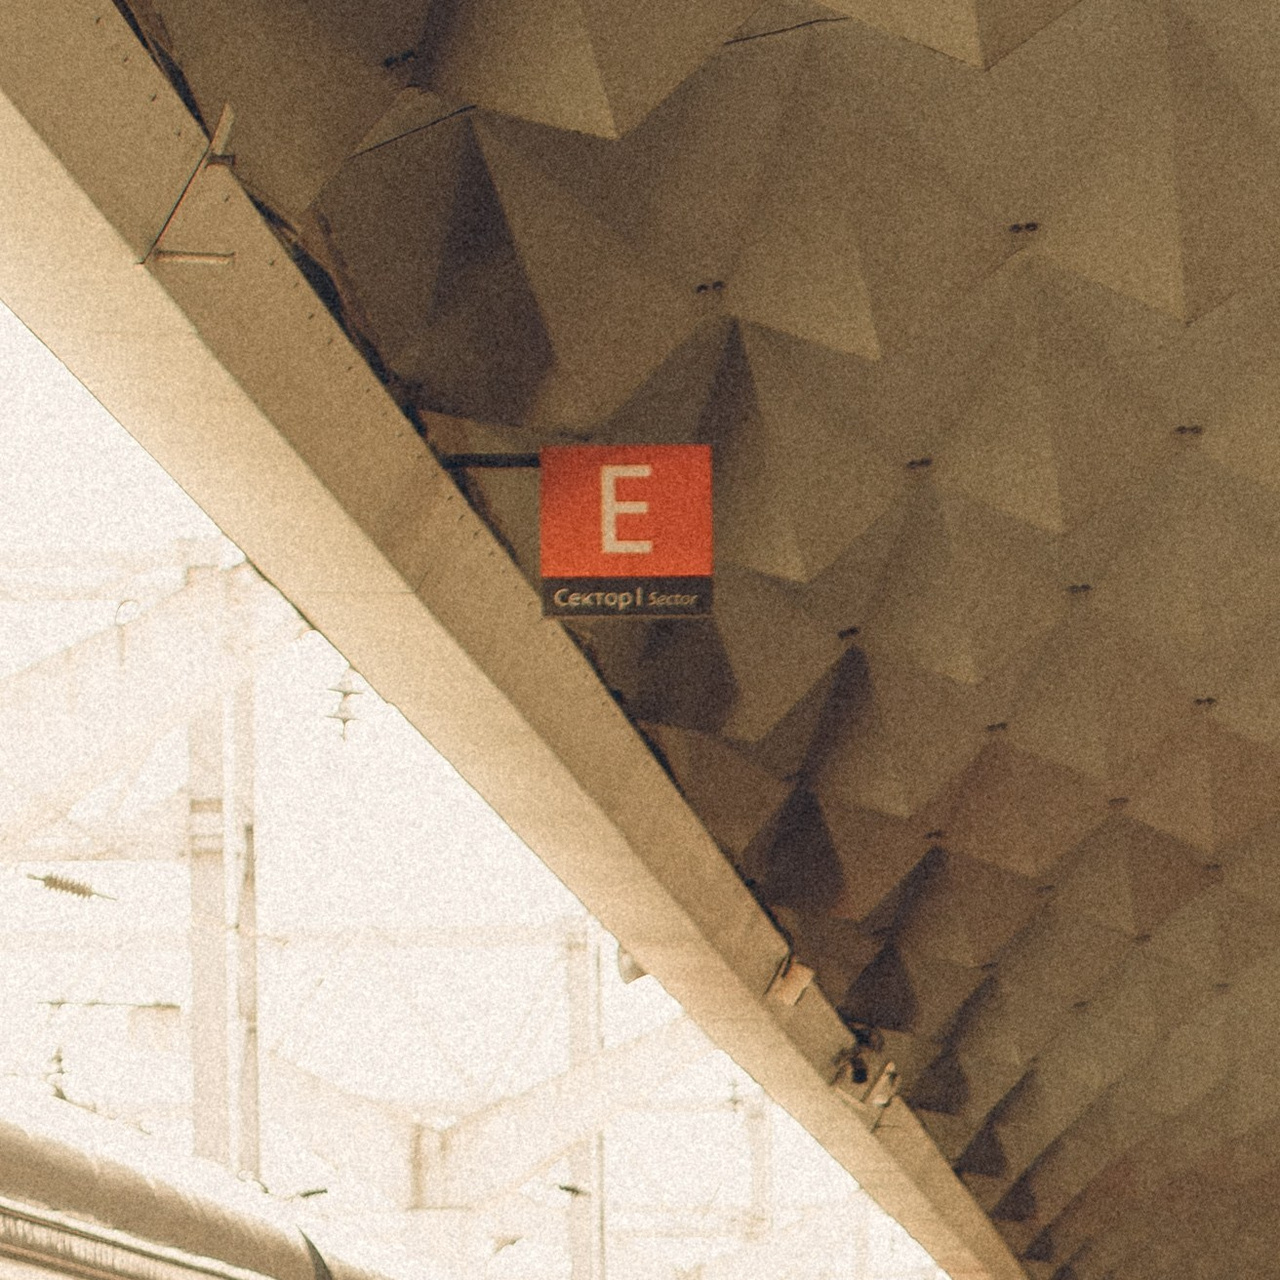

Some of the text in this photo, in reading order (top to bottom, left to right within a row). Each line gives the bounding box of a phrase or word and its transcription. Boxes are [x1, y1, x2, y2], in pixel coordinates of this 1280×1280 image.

[601, 464, 652, 554] E
[554, 588, 699, 611] Сектор Sector
